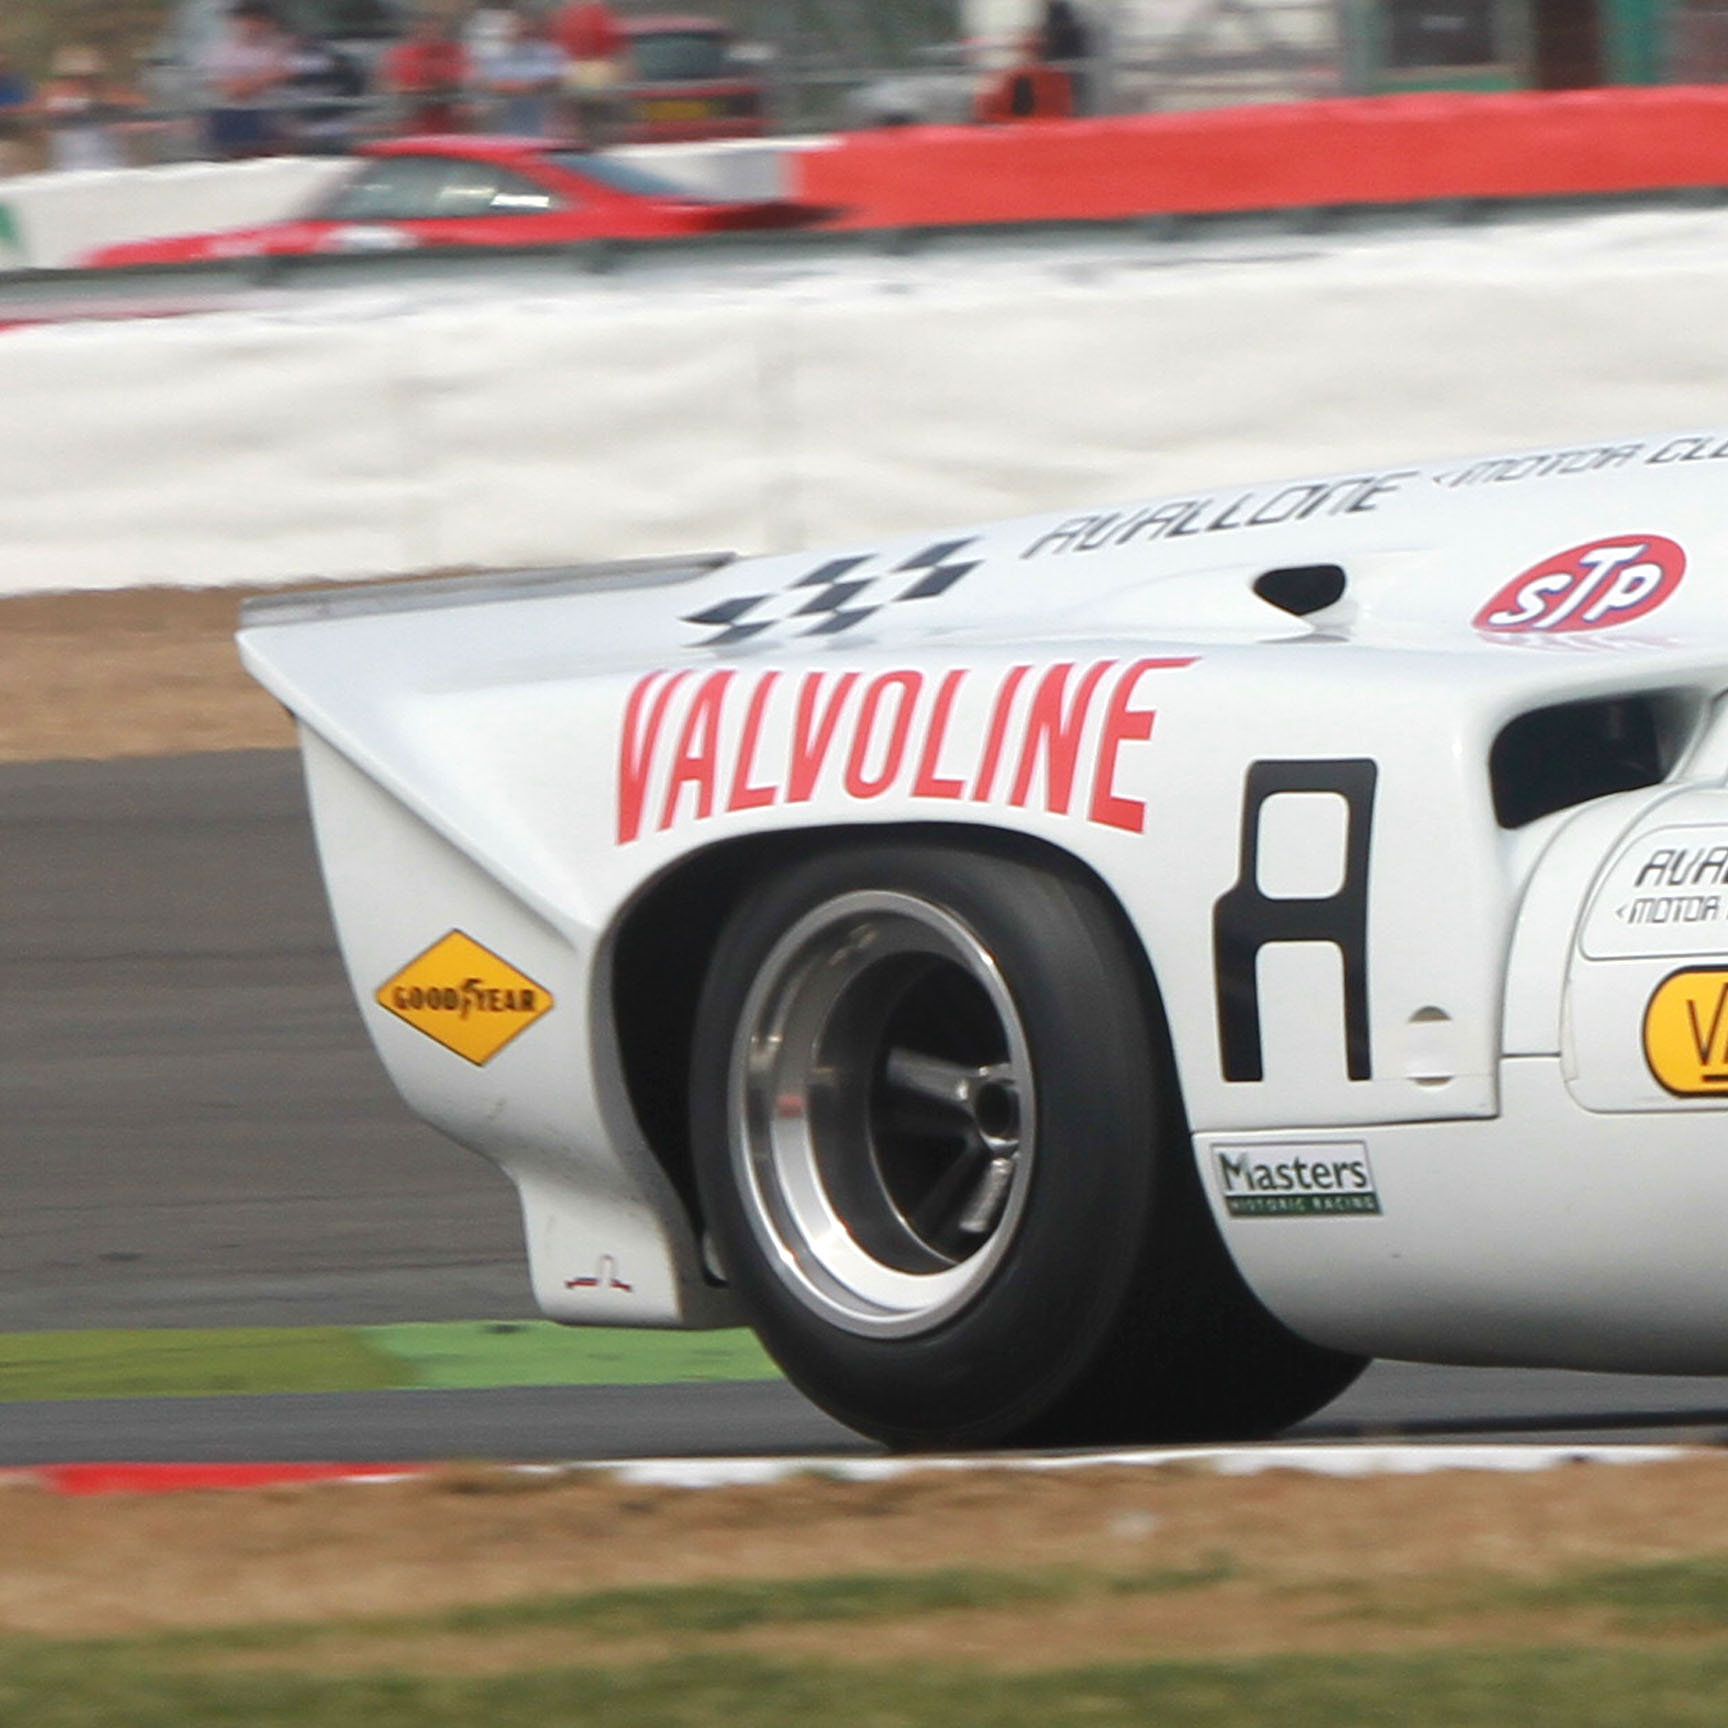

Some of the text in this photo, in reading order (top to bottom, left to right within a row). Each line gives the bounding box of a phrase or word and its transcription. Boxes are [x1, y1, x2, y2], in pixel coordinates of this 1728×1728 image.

[1020, 470, 1422, 561] AVALLONE
[1489, 544, 1661, 630] STP
[617, 656, 1203, 846] VALVOLINE
[1212, 758, 1378, 1083] A
[1218, 1152, 1367, 1191] Masters
